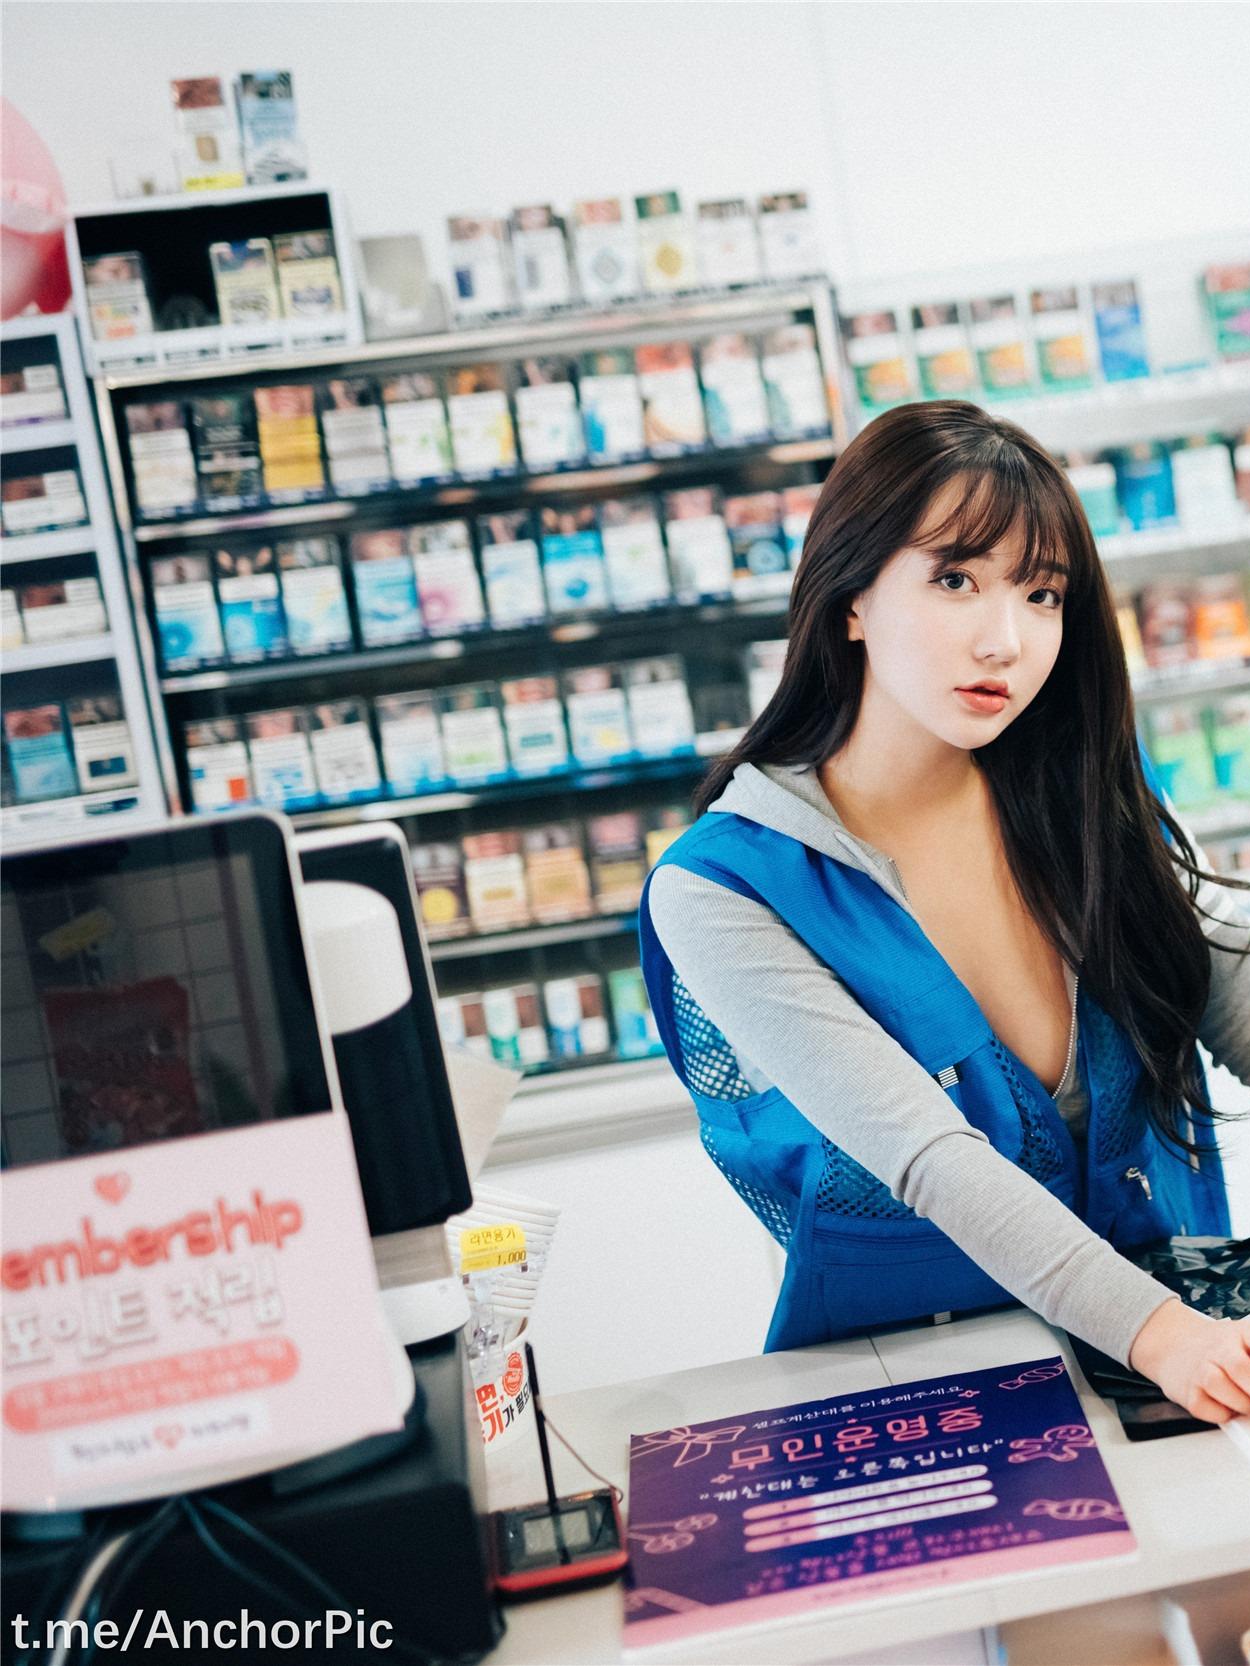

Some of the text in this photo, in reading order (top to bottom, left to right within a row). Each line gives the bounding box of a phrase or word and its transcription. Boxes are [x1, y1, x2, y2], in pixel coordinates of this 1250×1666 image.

[470, 1228, 517, 1246] 라면용기
[2, 1252, 286, 1371] 포인트 적립
[481, 1404, 515, 1444] 기가
[752, 1384, 964, 1430] 셀프계산대를 이용해주세요
[728, 1405, 984, 1470] 무인운영중
